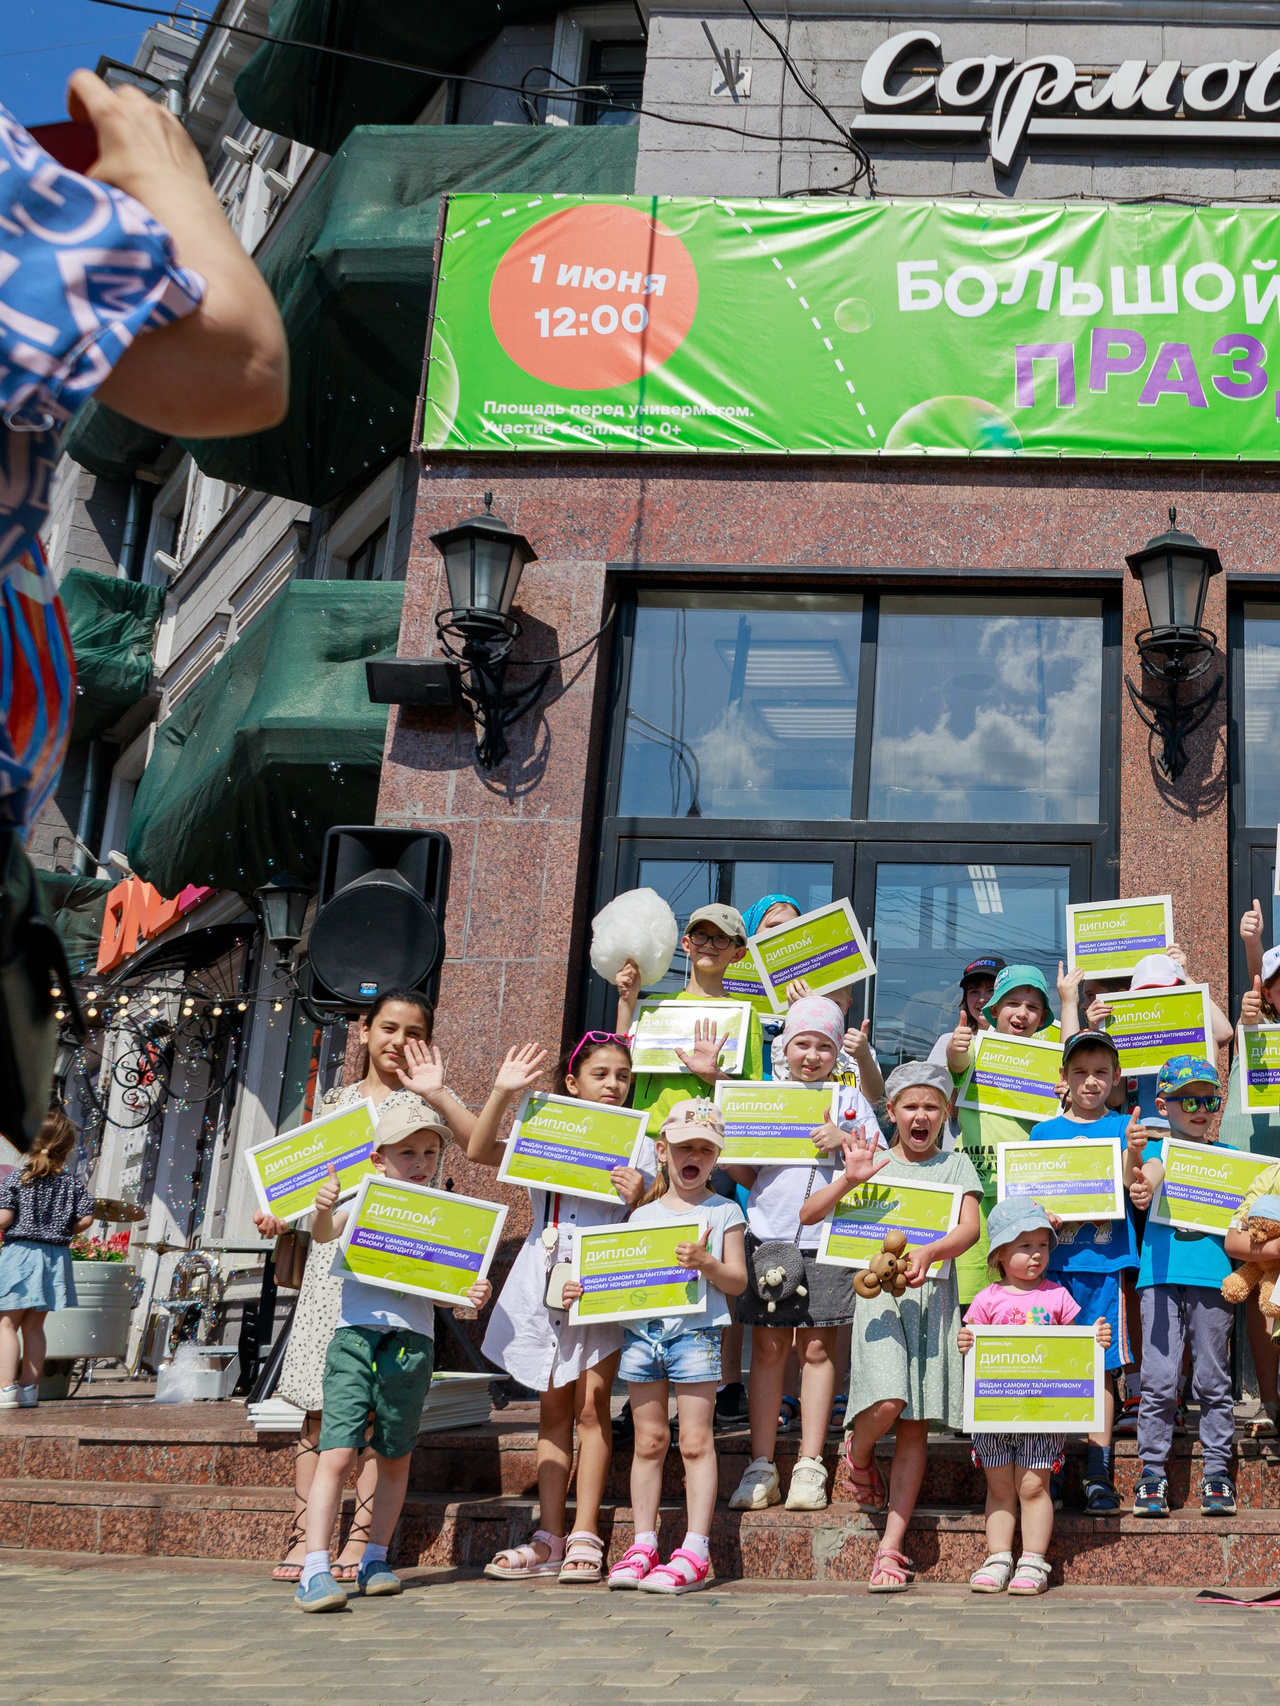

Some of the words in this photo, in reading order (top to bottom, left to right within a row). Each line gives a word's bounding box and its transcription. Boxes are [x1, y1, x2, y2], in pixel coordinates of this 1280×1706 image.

[530, 253, 544, 284] 1
[556, 262, 667, 297] июня
[534, 304, 650, 339] 12:00
[483, 401, 565, 416] Площадь
[570, 404, 625, 417] перед
[483, 421, 554, 435] Участие
[660, 422, 681, 436] 0+
[1078, 920, 1126, 932] ДИПЛОМ
[764, 937, 814, 963] ДИПЛОМ
[981, 1051, 1030, 1068] ДИПЛОМ
[726, 1102, 784, 1112] ДИПЛОМ
[527, 1115, 588, 1136] ДИПЛОМ
[263, 1141, 325, 1175] ДИПЛОМ
[296, 1170, 329, 1187] КОНДИТЕР
[1171, 1161, 1228, 1181] ДИПЛОМ
[367, 1202, 437, 1228] ДИПЛОМ
[356, 1237, 384, 1248] ЮНОМУ
[384, 1243, 426, 1257] КОНДИТЕРУ
[358, 1231, 384, 1242] ВЫДАН
[384, 1236, 416, 1248] САМОМУ
[414, 1243, 470, 1260] ТАЛАНТЛИВОМУ
[585, 1246, 647, 1263] ДИПЛОМ
[585, 1277, 606, 1285] ВЫДАН
[608, 1274, 636, 1282] САМОМУ
[636, 1269, 685, 1280] ТАЛАНТЛИВОМУ
[610, 1279, 647, 1288] КОНДИТЕРУ
[980, 1353, 1042, 1365] ДИПЛОМ
